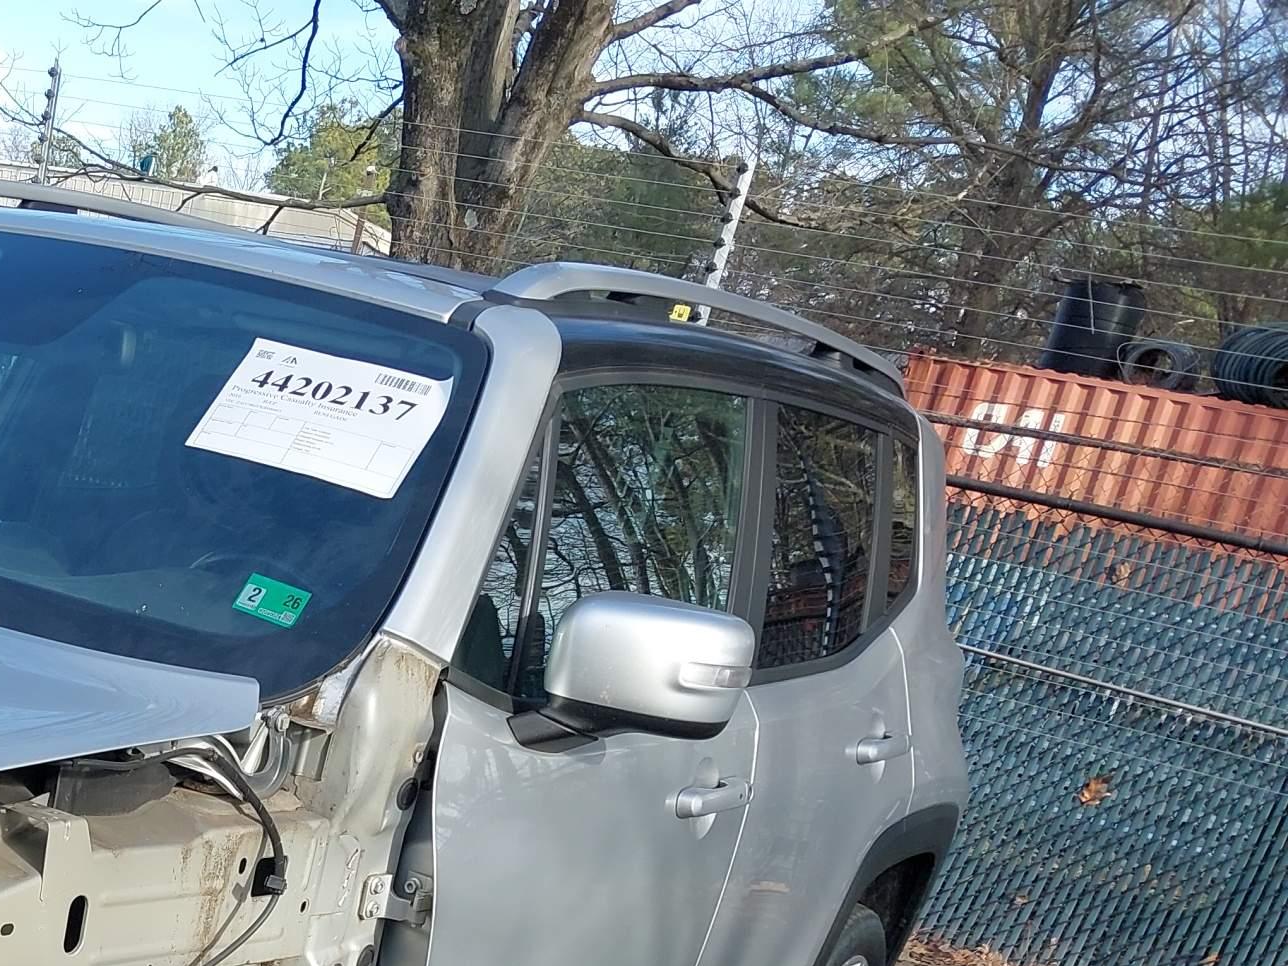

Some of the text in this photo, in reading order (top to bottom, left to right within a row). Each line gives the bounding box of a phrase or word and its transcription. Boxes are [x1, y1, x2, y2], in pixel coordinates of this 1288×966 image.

[232, 385, 279, 400] Progressive
[281, 394, 315, 408] Casualty
[318, 402, 359, 417] Insurance
[251, 370, 419, 420] 44202137
[247, 587, 262, 602] 2
[283, 594, 302, 610] 26
